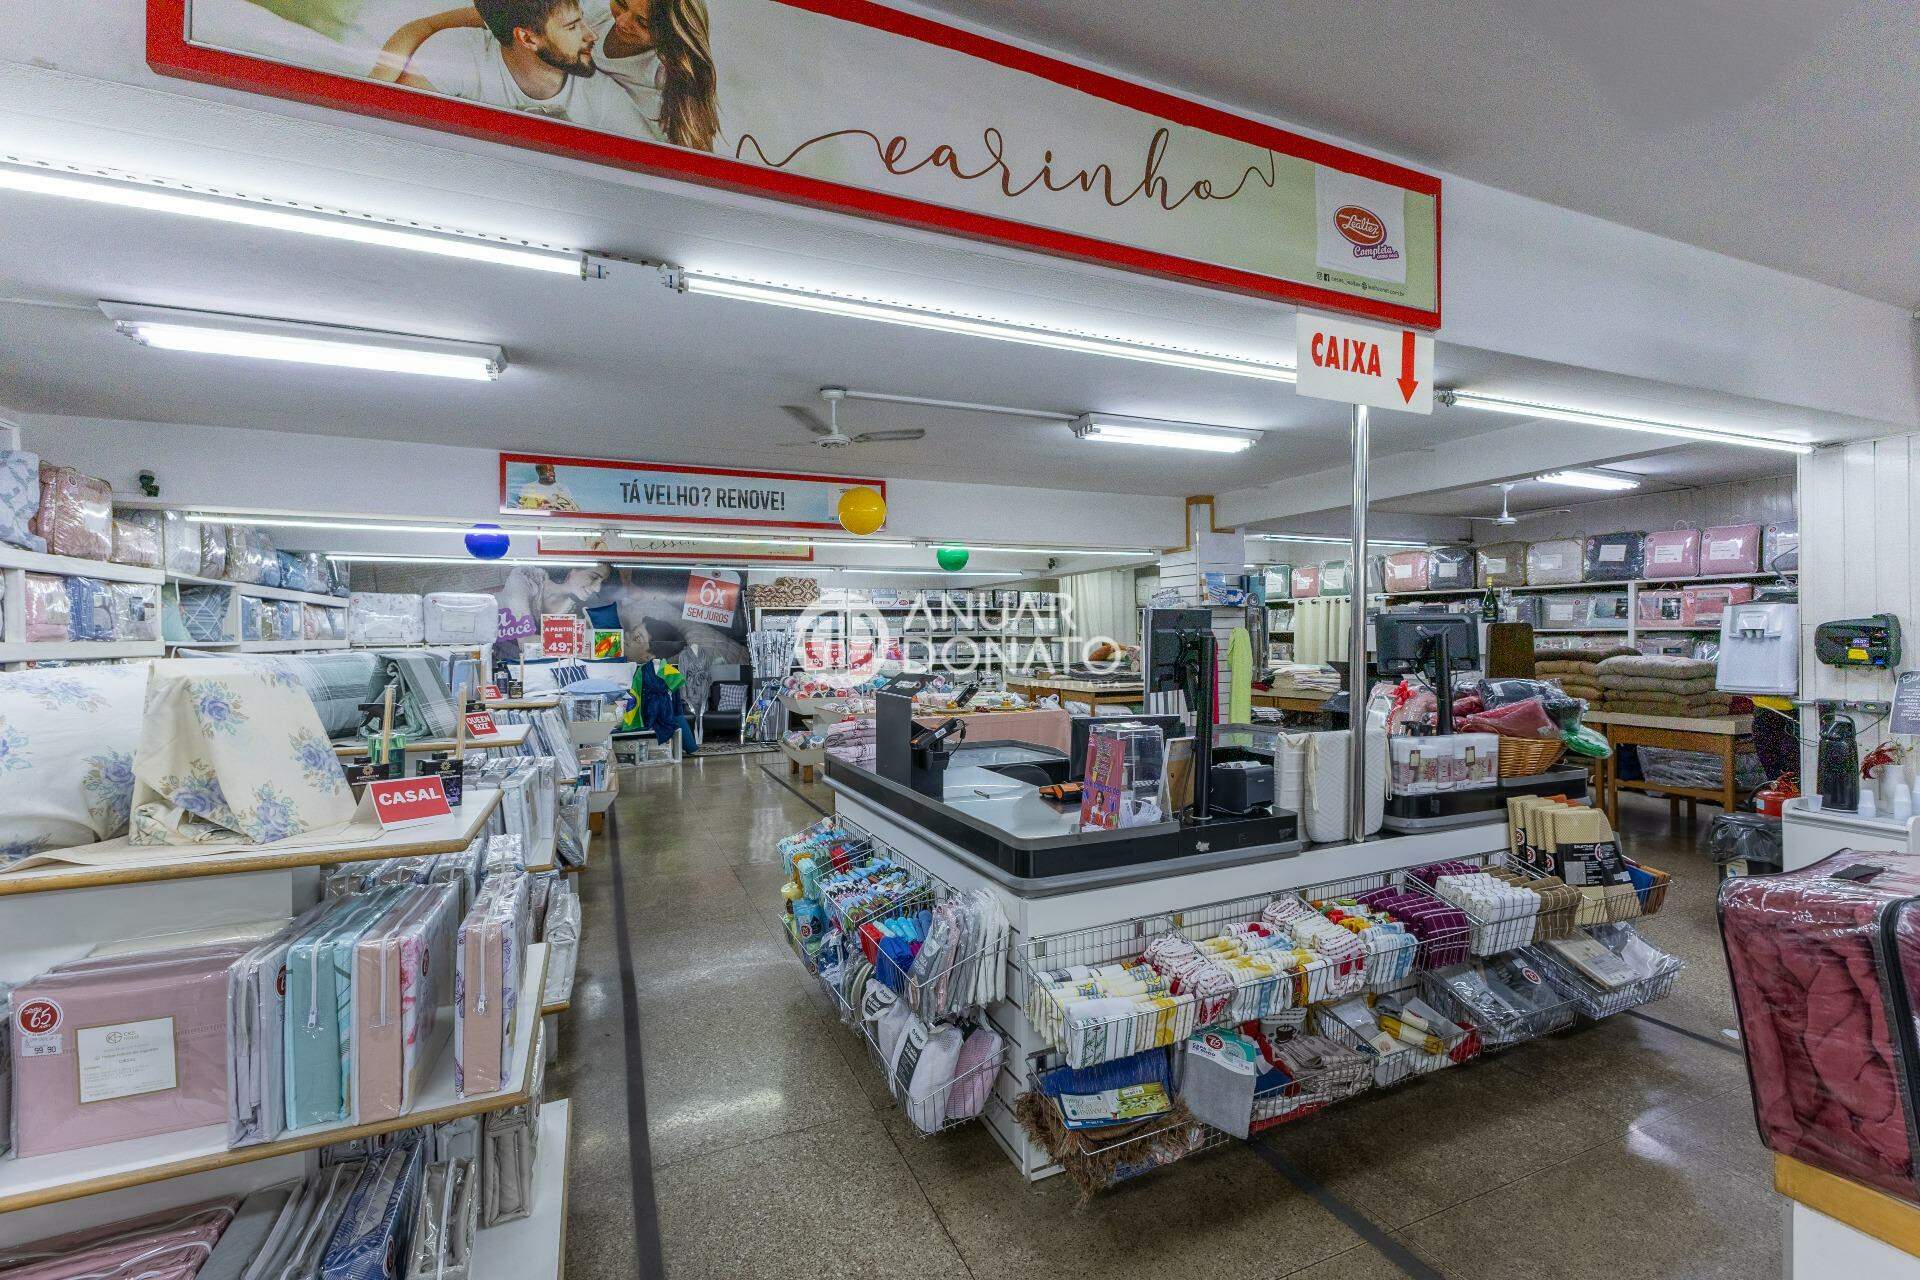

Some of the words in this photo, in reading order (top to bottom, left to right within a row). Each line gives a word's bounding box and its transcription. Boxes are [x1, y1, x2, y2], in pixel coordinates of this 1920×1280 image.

[1312, 332, 1381, 377] CAIXA
[620, 479, 641, 503] TÁ
[645, 485, 711, 507] VELHO?
[716, 487, 786, 511] RENOVE!
[687, 607, 703, 619] SEM
[704, 610, 729, 624] JUROS
[466, 715, 491, 725] QUEEN
[473, 723, 491, 731] SIZE
[378, 787, 442, 806] CASAL
